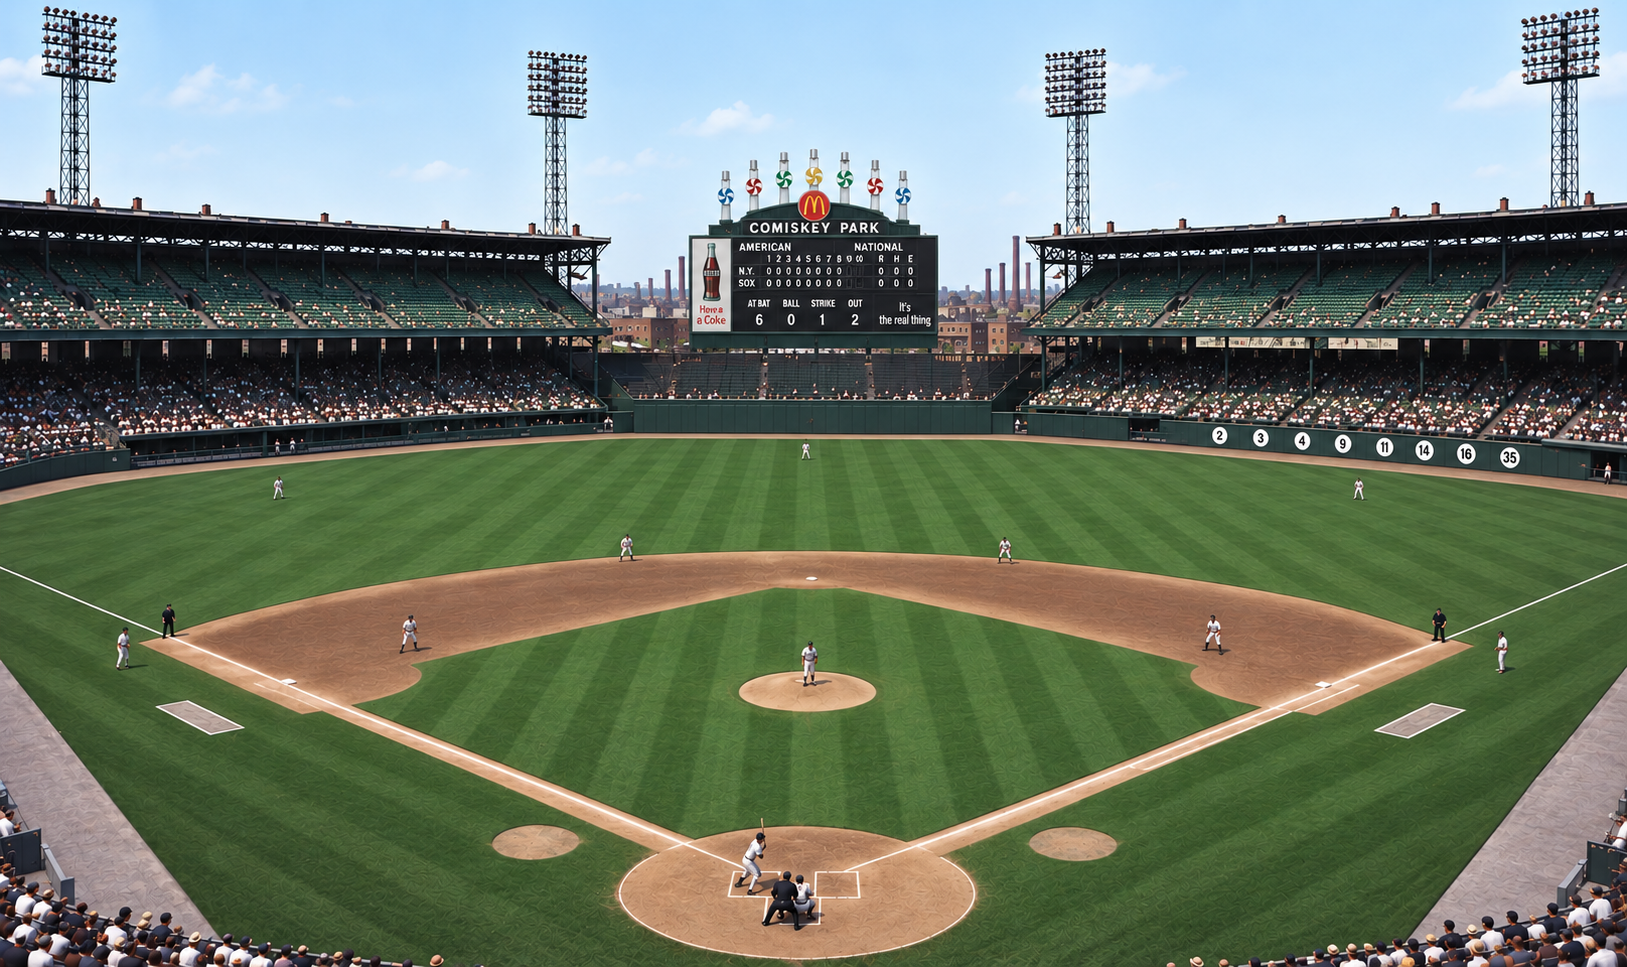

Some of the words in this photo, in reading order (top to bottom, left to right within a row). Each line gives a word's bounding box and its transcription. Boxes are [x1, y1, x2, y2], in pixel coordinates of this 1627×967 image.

[749, 222, 831, 234] COMISKEY
[840, 222, 880, 234] PARK
[738, 242, 792, 252] AMERICAN
[854, 242, 904, 252] NATIONAL
[775, 254, 782, 263] 2
[785, 254, 792, 263] 3
[795, 254, 802, 263] 4
[815, 254, 822, 263] 6
[826, 254, 832, 263] 7
[836, 254, 842, 263] 8
[878, 254, 884, 263] R
[893, 254, 900, 263] H
[907, 254, 914, 263] E
[738, 266, 755, 276] N.Y.
[766, 266, 772, 276] 0
[775, 266, 782, 276] 0
[785, 266, 792, 276] 0
[795, 266, 802, 276] 0
[805, 266, 812, 276] 0
[815, 266, 822, 276] 0
[826, 266, 832, 276] 0
[836, 266, 842, 276] 0
[878, 266, 884, 276] 0
[893, 266, 900, 276] 0
[907, 266, 914, 276] 0
[738, 278, 756, 288] SOX
[766, 278, 772, 288] 0
[775, 278, 782, 288] 0
[785, 278, 792, 288] 0
[795, 278, 802, 288] 0
[805, 278, 812, 288] 0
[815, 278, 822, 288] 0
[826, 278, 832, 288] 0
[836, 278, 842, 288] 0
[878, 278, 884, 288] 0
[893, 278, 900, 288] 0
[907, 278, 914, 288] 0
[747, 299, 757, 308] AT
[757, 299, 771, 308] BAT
[782, 299, 800, 308] BALL
[810, 299, 836, 308] STRIKE
[847, 299, 863, 308] OUT
[899, 301, 911, 312] It's
[696, 317, 703, 325] a
[704, 315, 727, 325] Coke
[755, 313, 764, 326] 6
[787, 313, 796, 326] 0
[819, 313, 826, 326] 1
[851, 313, 860, 326] 2
[878, 314, 893, 325] the
[894, 314, 909, 325] real
[910, 314, 932, 328] thing
[1216, 430, 1223, 441] 2
[1257, 432, 1265, 444] 3
[1298, 435, 1306, 447] 4
[1339, 438, 1347, 450] 9
[1380, 441, 1389, 453] 11
[1418, 444, 1430, 457] 14
[1460, 447, 1473, 460] 16
[1502, 450, 1517, 464] 35
